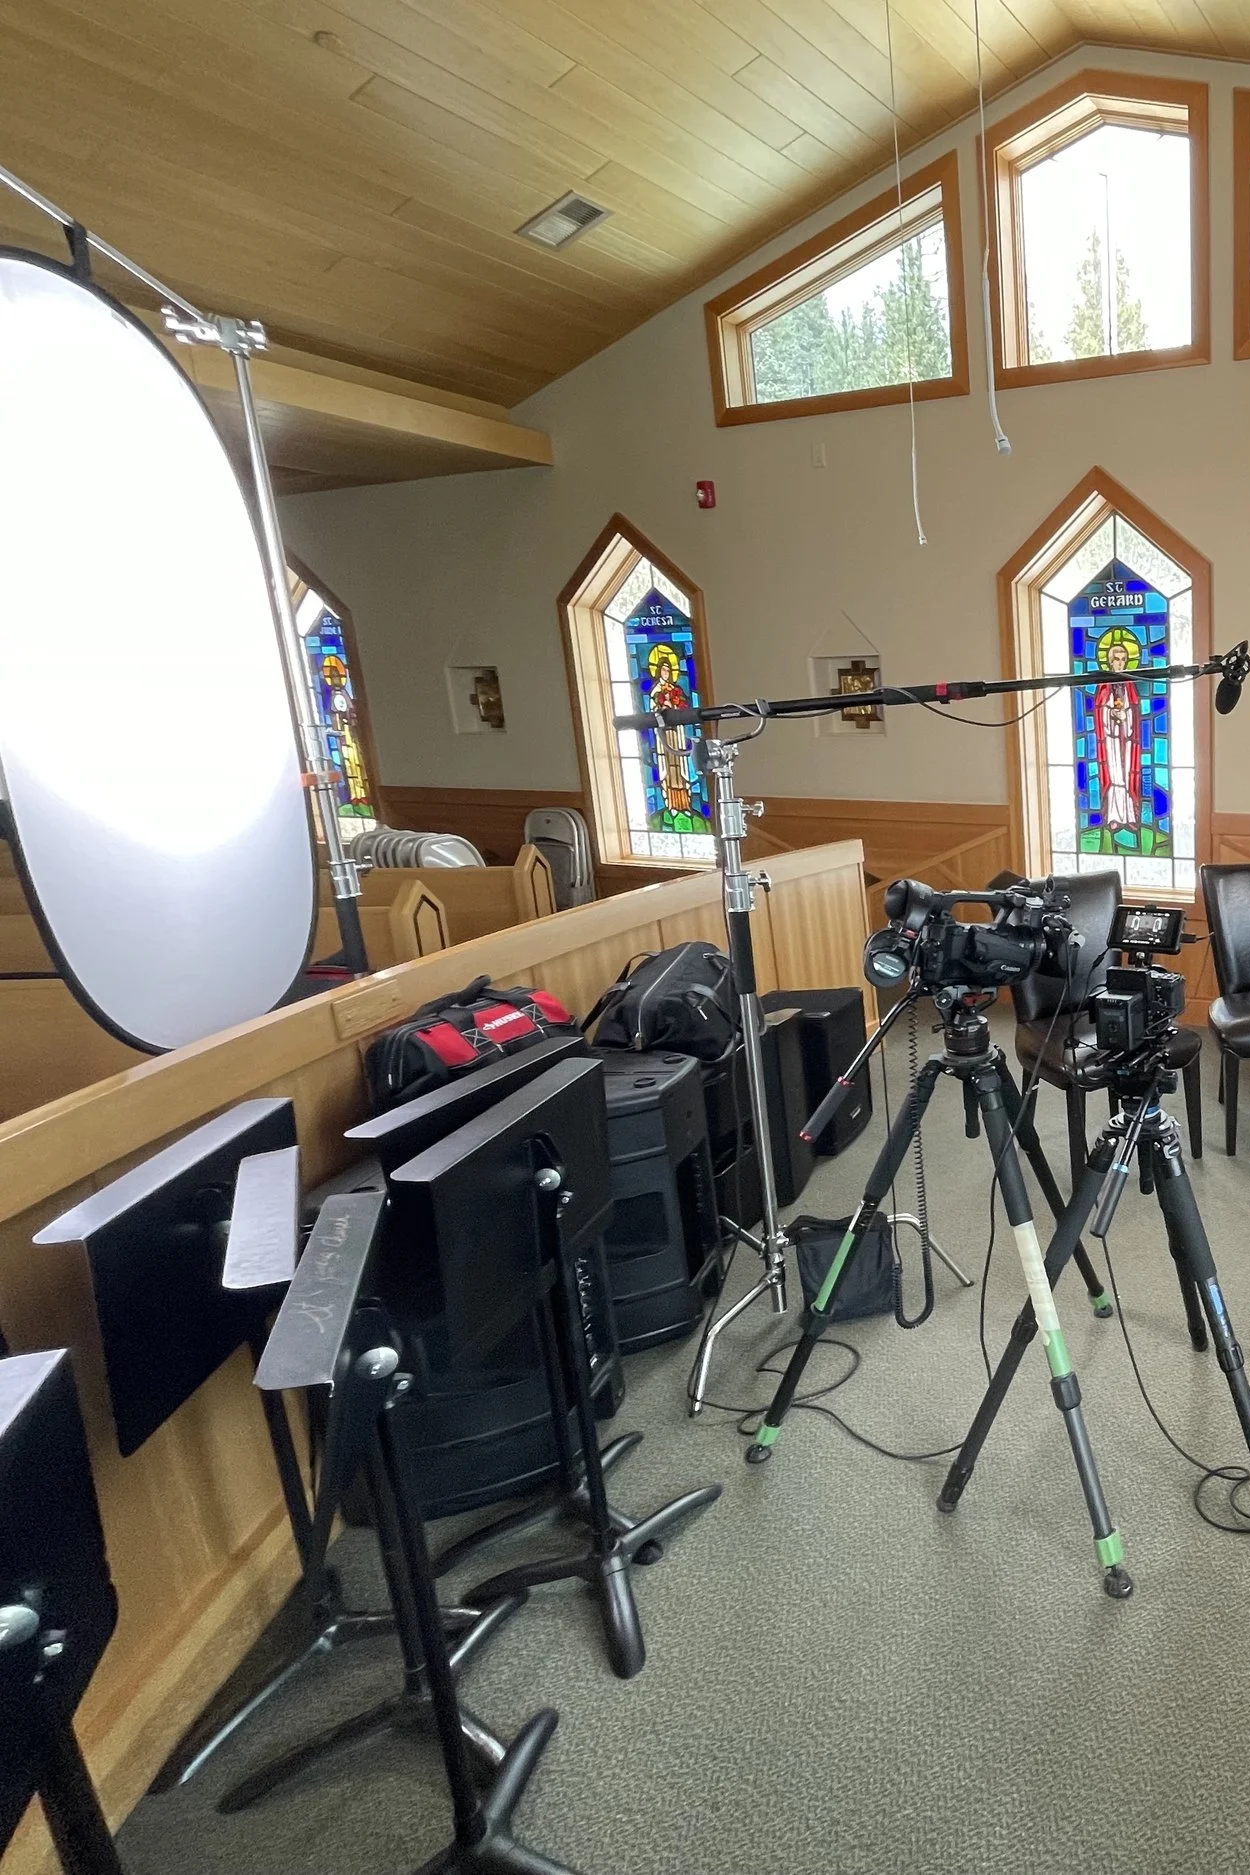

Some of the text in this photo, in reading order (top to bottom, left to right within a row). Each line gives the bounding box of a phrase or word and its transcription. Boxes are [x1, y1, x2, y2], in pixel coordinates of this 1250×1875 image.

[1105, 581, 1123, 593] ST
[1090, 594, 1143, 608] GERARD
[649, 605, 662, 615] ST
[640, 616, 673, 626] TERESA
